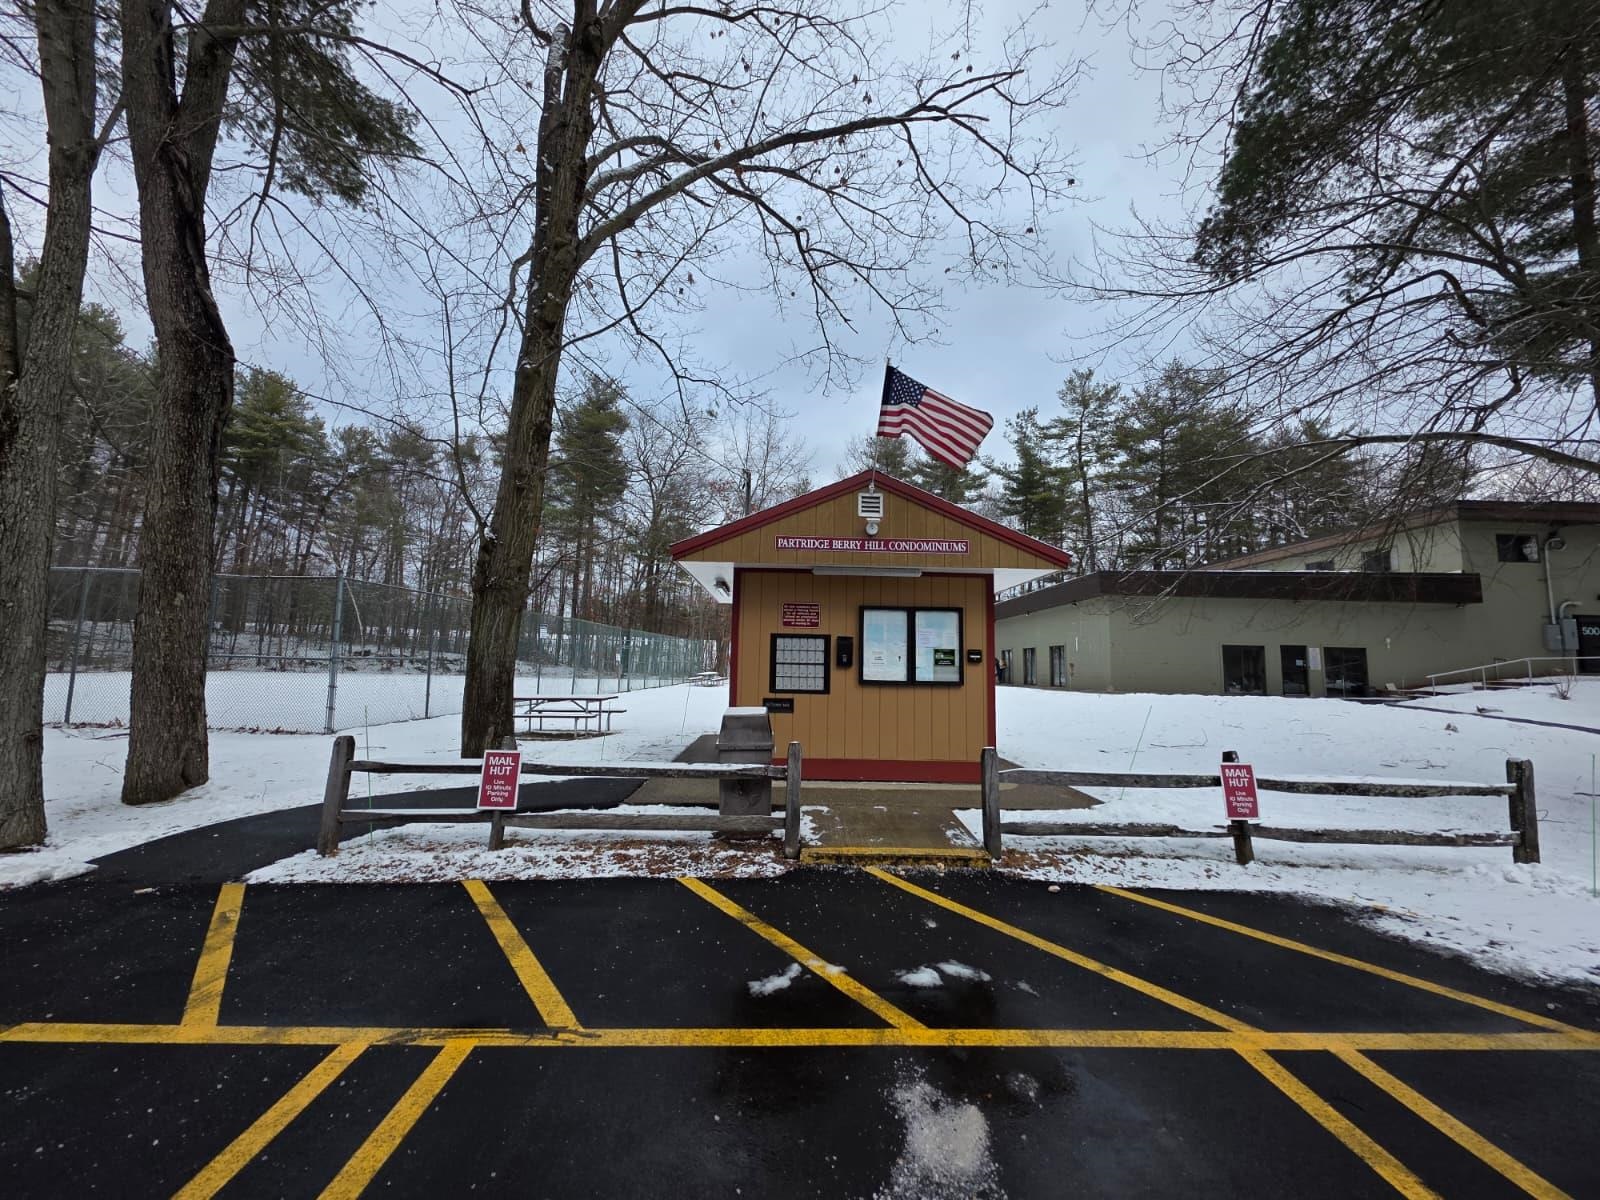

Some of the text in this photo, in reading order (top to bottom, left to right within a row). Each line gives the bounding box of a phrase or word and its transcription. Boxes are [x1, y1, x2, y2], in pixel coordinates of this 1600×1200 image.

[778, 538, 967, 552] PARTRIDGE BERRY HILL CONDOMINIUMS
[489, 756, 515, 766] MAIL
[489, 766, 513, 776] HUT
[1225, 769, 1250, 778] MAIL
[1228, 778, 1249, 788] HUT
